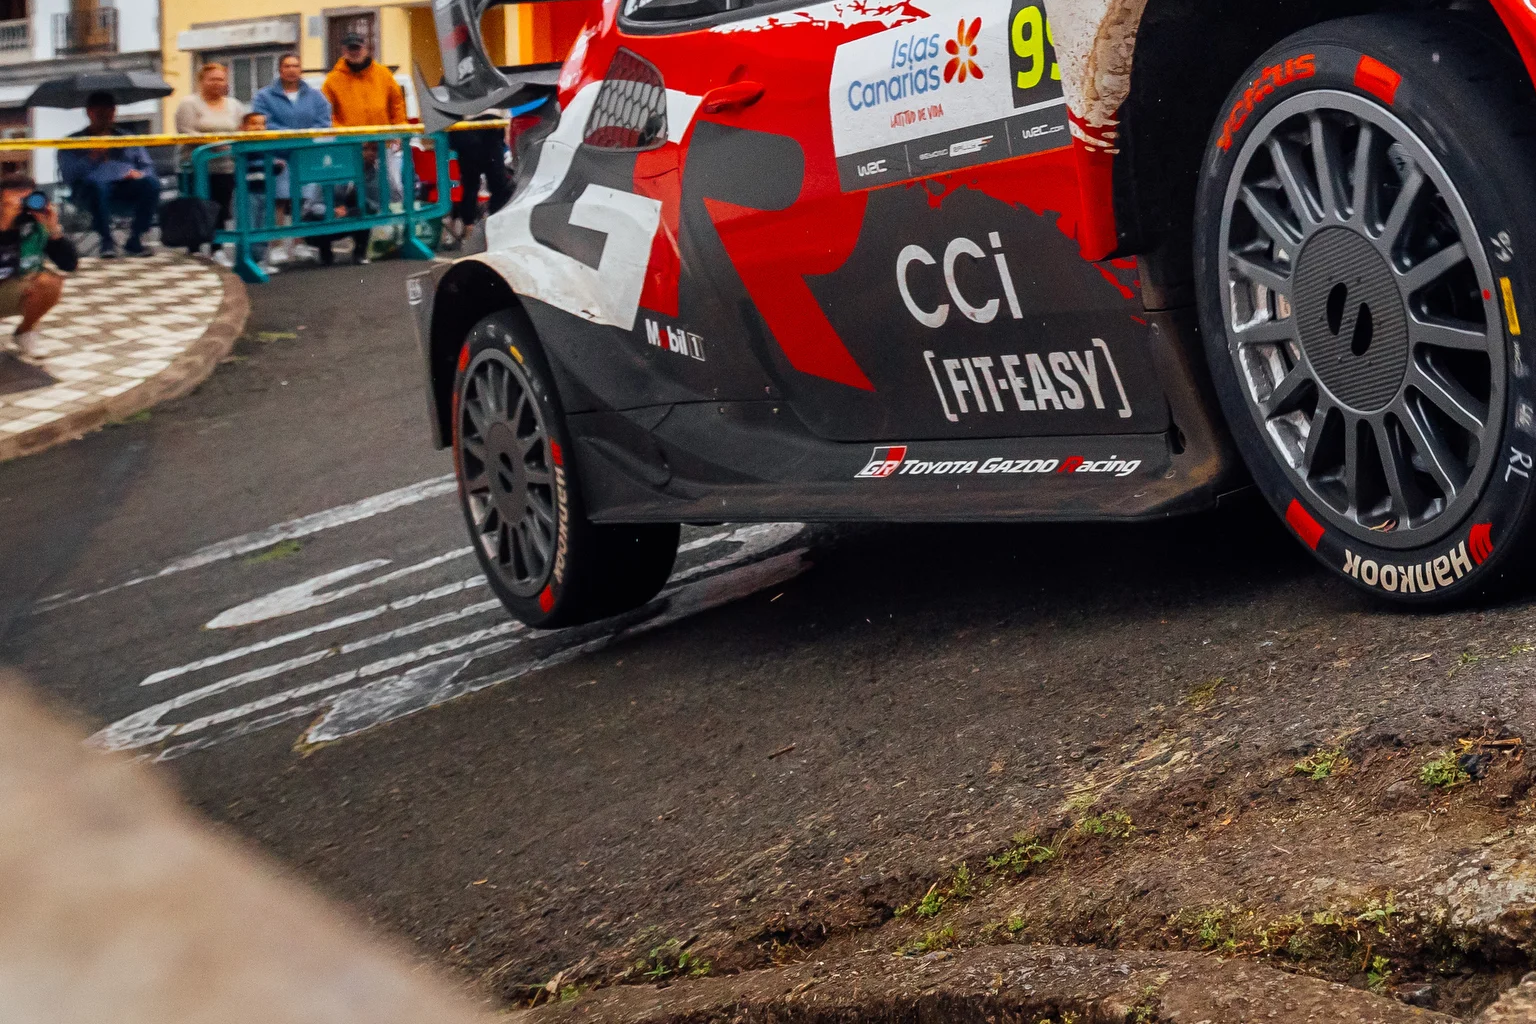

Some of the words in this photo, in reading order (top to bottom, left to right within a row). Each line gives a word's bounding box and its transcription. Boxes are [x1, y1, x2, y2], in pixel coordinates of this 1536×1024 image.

[890, 32, 940, 69] Islas
[847, 63, 941, 112] Canarias
[857, 159, 888, 177] WRC
[645, 318, 689, 356] Mobil
[865, 459, 899, 476] GR
[1056, 454, 1142, 477] Racing
